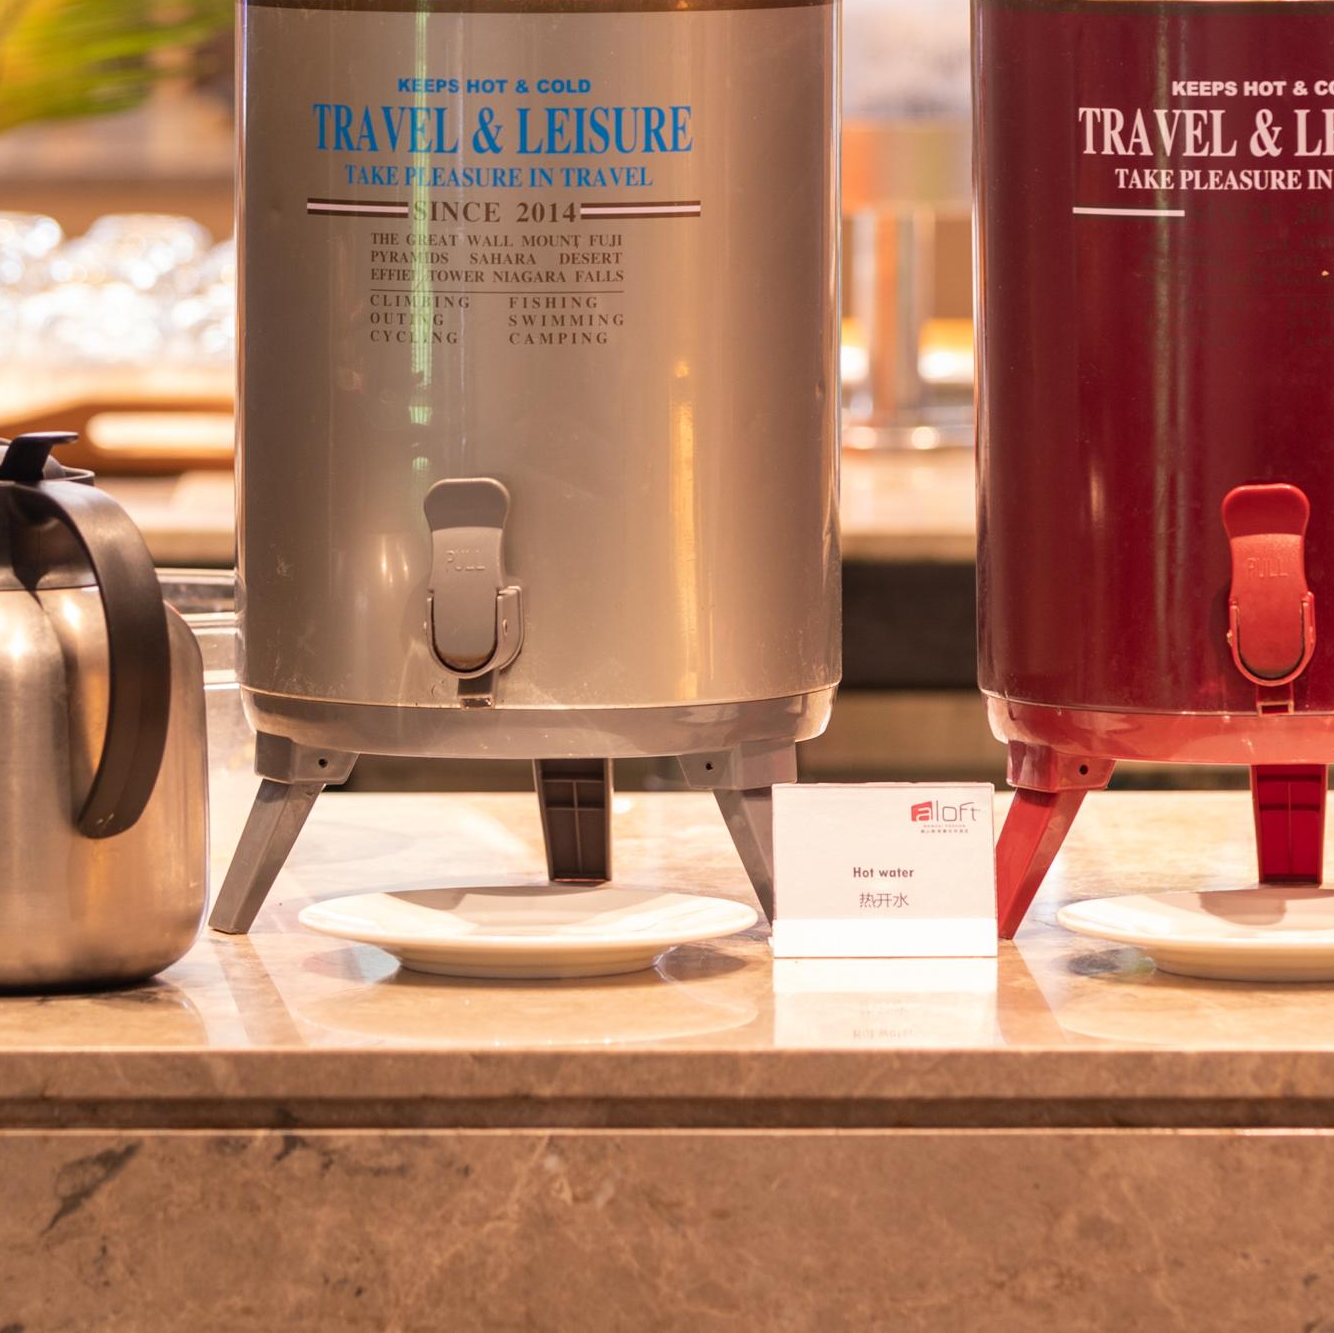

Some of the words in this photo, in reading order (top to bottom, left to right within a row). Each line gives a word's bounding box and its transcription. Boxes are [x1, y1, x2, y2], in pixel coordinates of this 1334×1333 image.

[397, 78, 460, 94] KEEPS
[466, 78, 508, 94] HOT
[515, 78, 530, 94] &
[536, 78, 592, 94] COLD
[1172, 81, 1238, 97] KEEPS
[1243, 81, 1287, 96] HOT
[1292, 81, 1308, 96] &
[312, 102, 460, 154] TRAVEL
[472, 106, 504, 155] &
[516, 105, 694, 155] LEISURE
[1078, 106, 1238, 157] TRAVEL
[1249, 107, 1283, 157] &
[344, 164, 399, 186] TAKE
[404, 164, 523, 188] PLEASURE
[528, 166, 558, 187] IN
[561, 165, 653, 188] TRAVEL
[1114, 168, 1174, 190] TAKE
[1179, 168, 1302, 190] PLEASURE
[1307, 168, 1333, 189] IN
[413, 201, 501, 223] SINCE
[516, 201, 577, 223] 2014
[370, 232, 400, 246] THE
[406, 233, 459, 247] GREAT
[467, 234, 514, 248] WALL
[522, 234, 582, 248] MOUNT
[589, 234, 623, 247] FUJI
[370, 249, 450, 264] PYRAMIDS
[469, 252, 537, 265] SAHARA
[559, 252, 623, 265] DESERT
[428, 269, 485, 283] TOWER
[492, 270, 567, 283] NIAGARA
[575, 269, 624, 283] FALLS
[370, 294, 471, 308] CLIMBING
[509, 296, 598, 309] FISHING
[370, 312, 445, 326] OUTING
[508, 313, 625, 327] SWIMMING
[509, 331, 608, 345] CAMPING
[445, 549, 485, 570] PULL
[1246, 557, 1289, 578] PULL
[910, 800, 981, 822] aloft
[853, 866, 874, 878] Hot
[879, 868, 915, 878] water
[859, 892, 910, 908] 热开水
